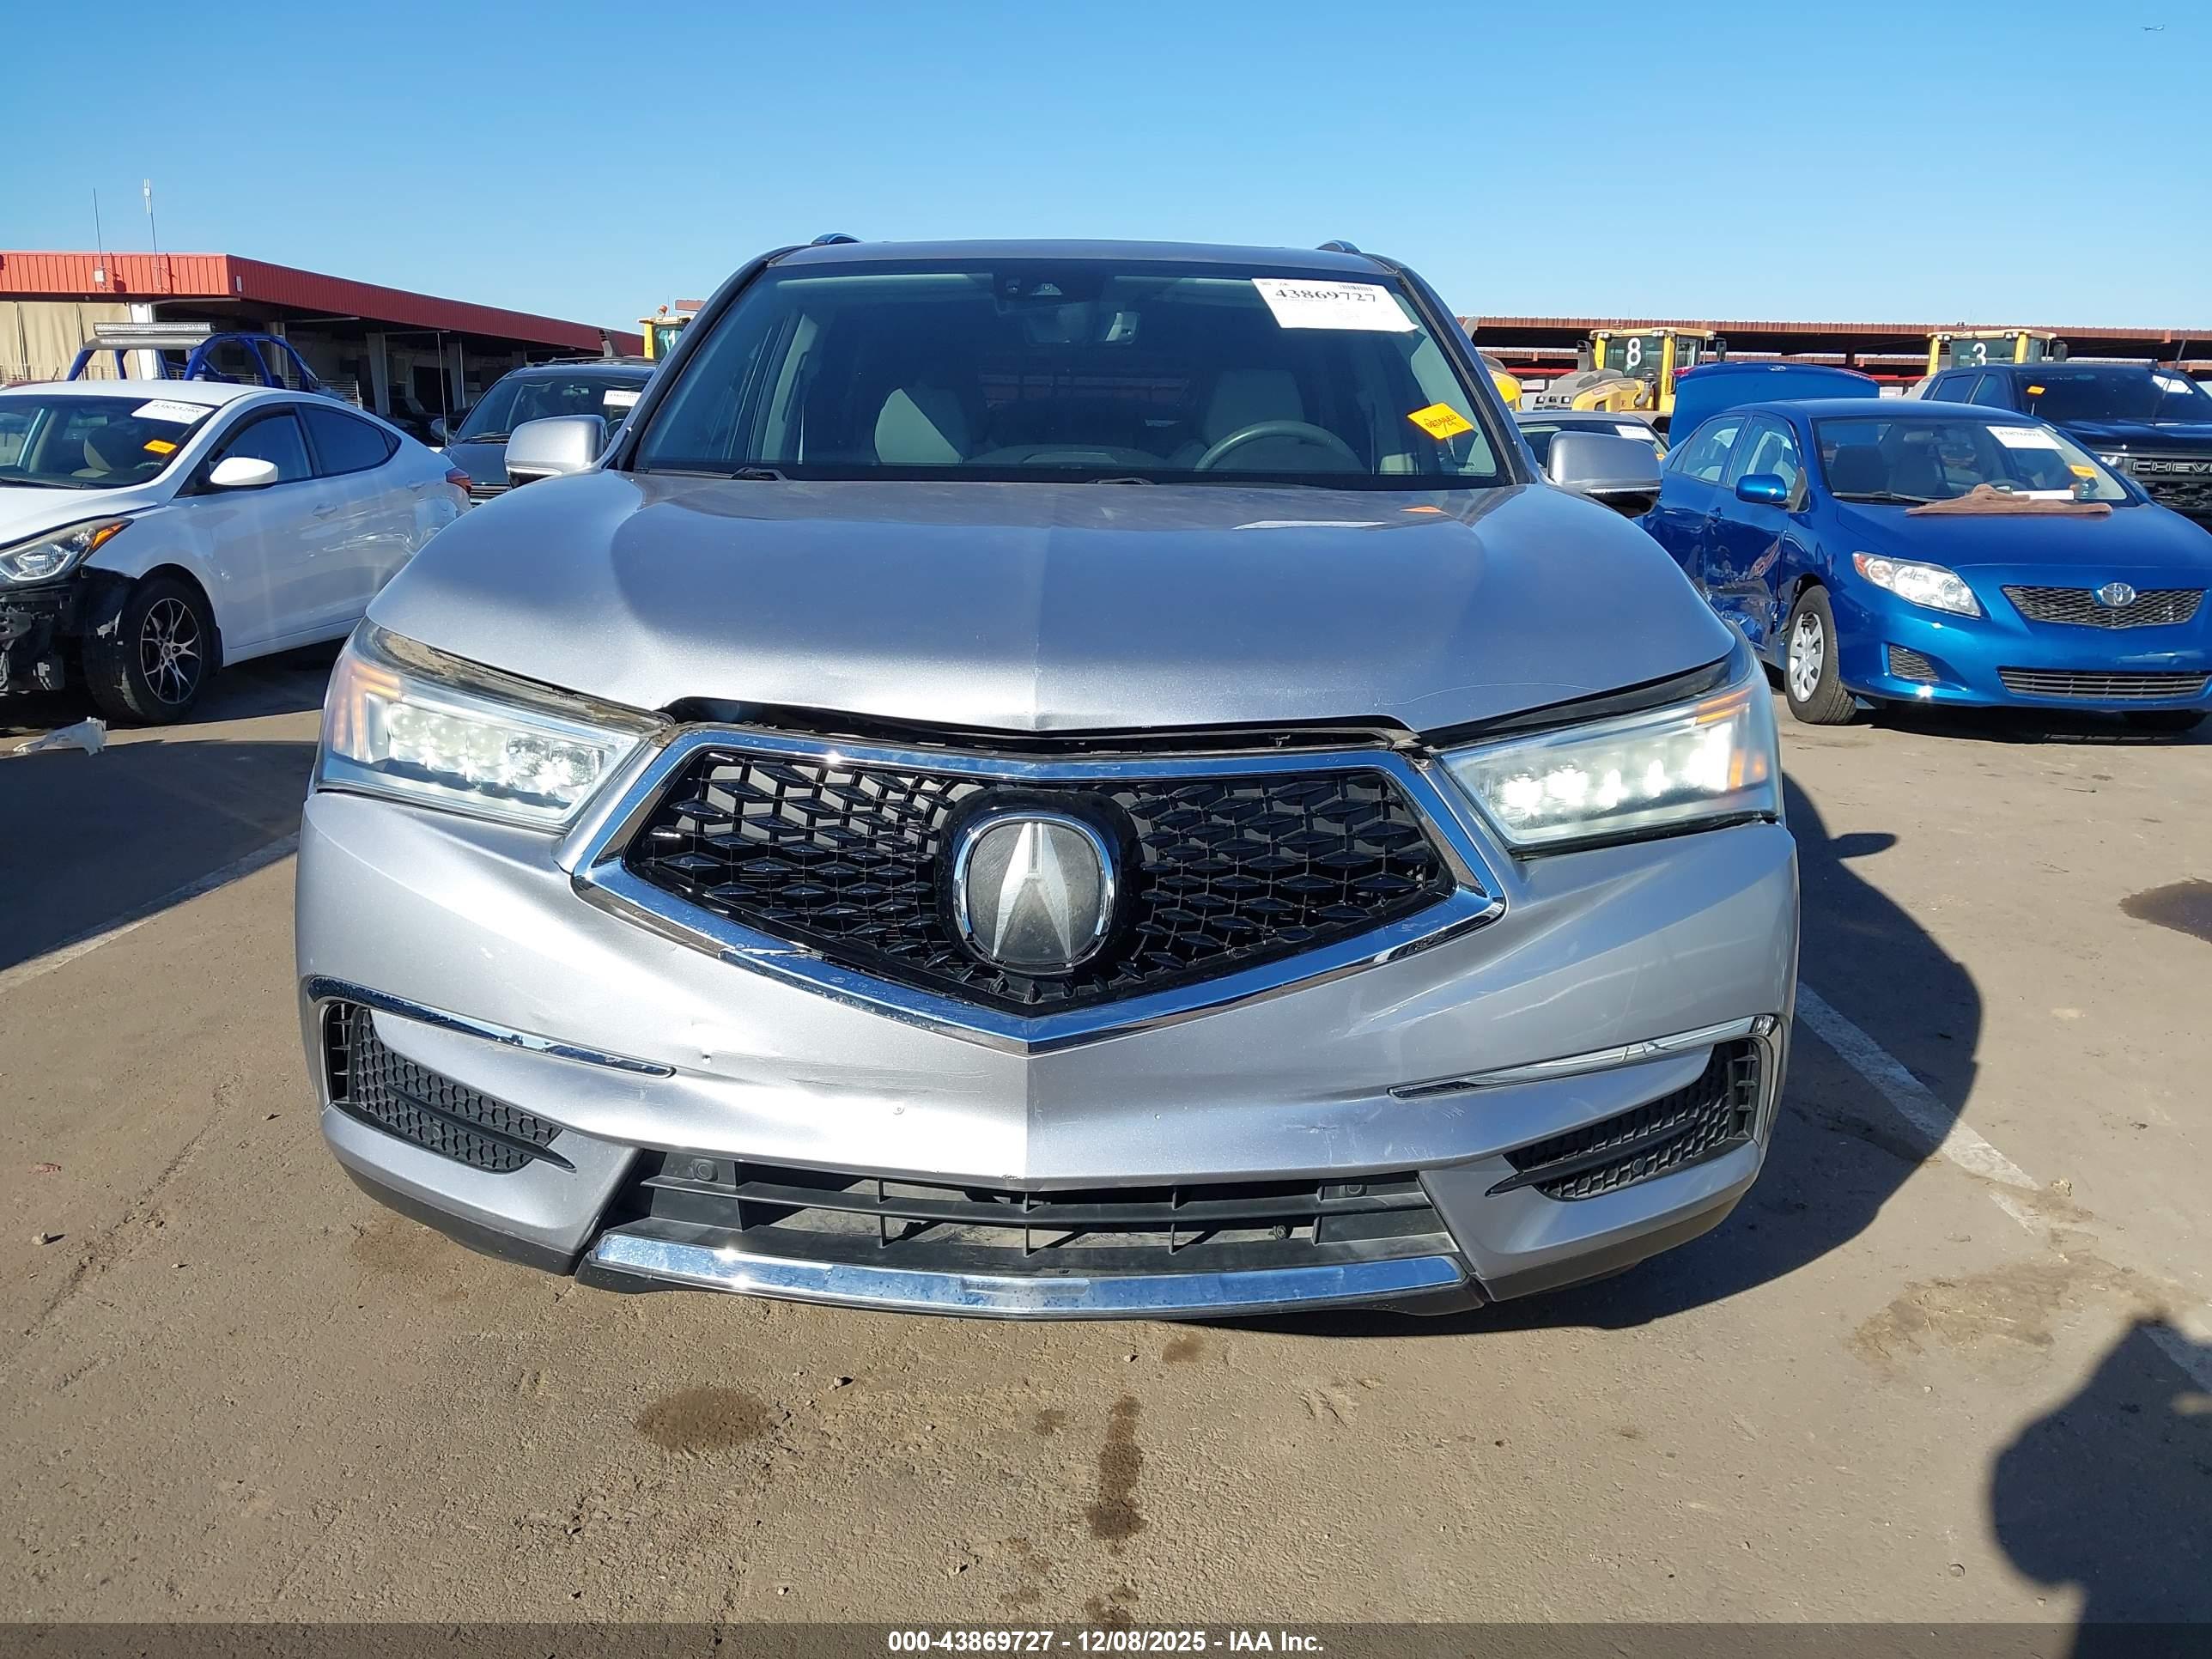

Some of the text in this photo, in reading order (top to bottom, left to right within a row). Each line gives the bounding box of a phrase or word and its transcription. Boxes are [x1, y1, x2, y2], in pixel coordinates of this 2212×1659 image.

[1275, 289, 1376, 302] 43869727
[1626, 337, 1641, 367] 8
[1972, 342, 1987, 367] 3
[2132, 461, 2212, 473] CHEV
